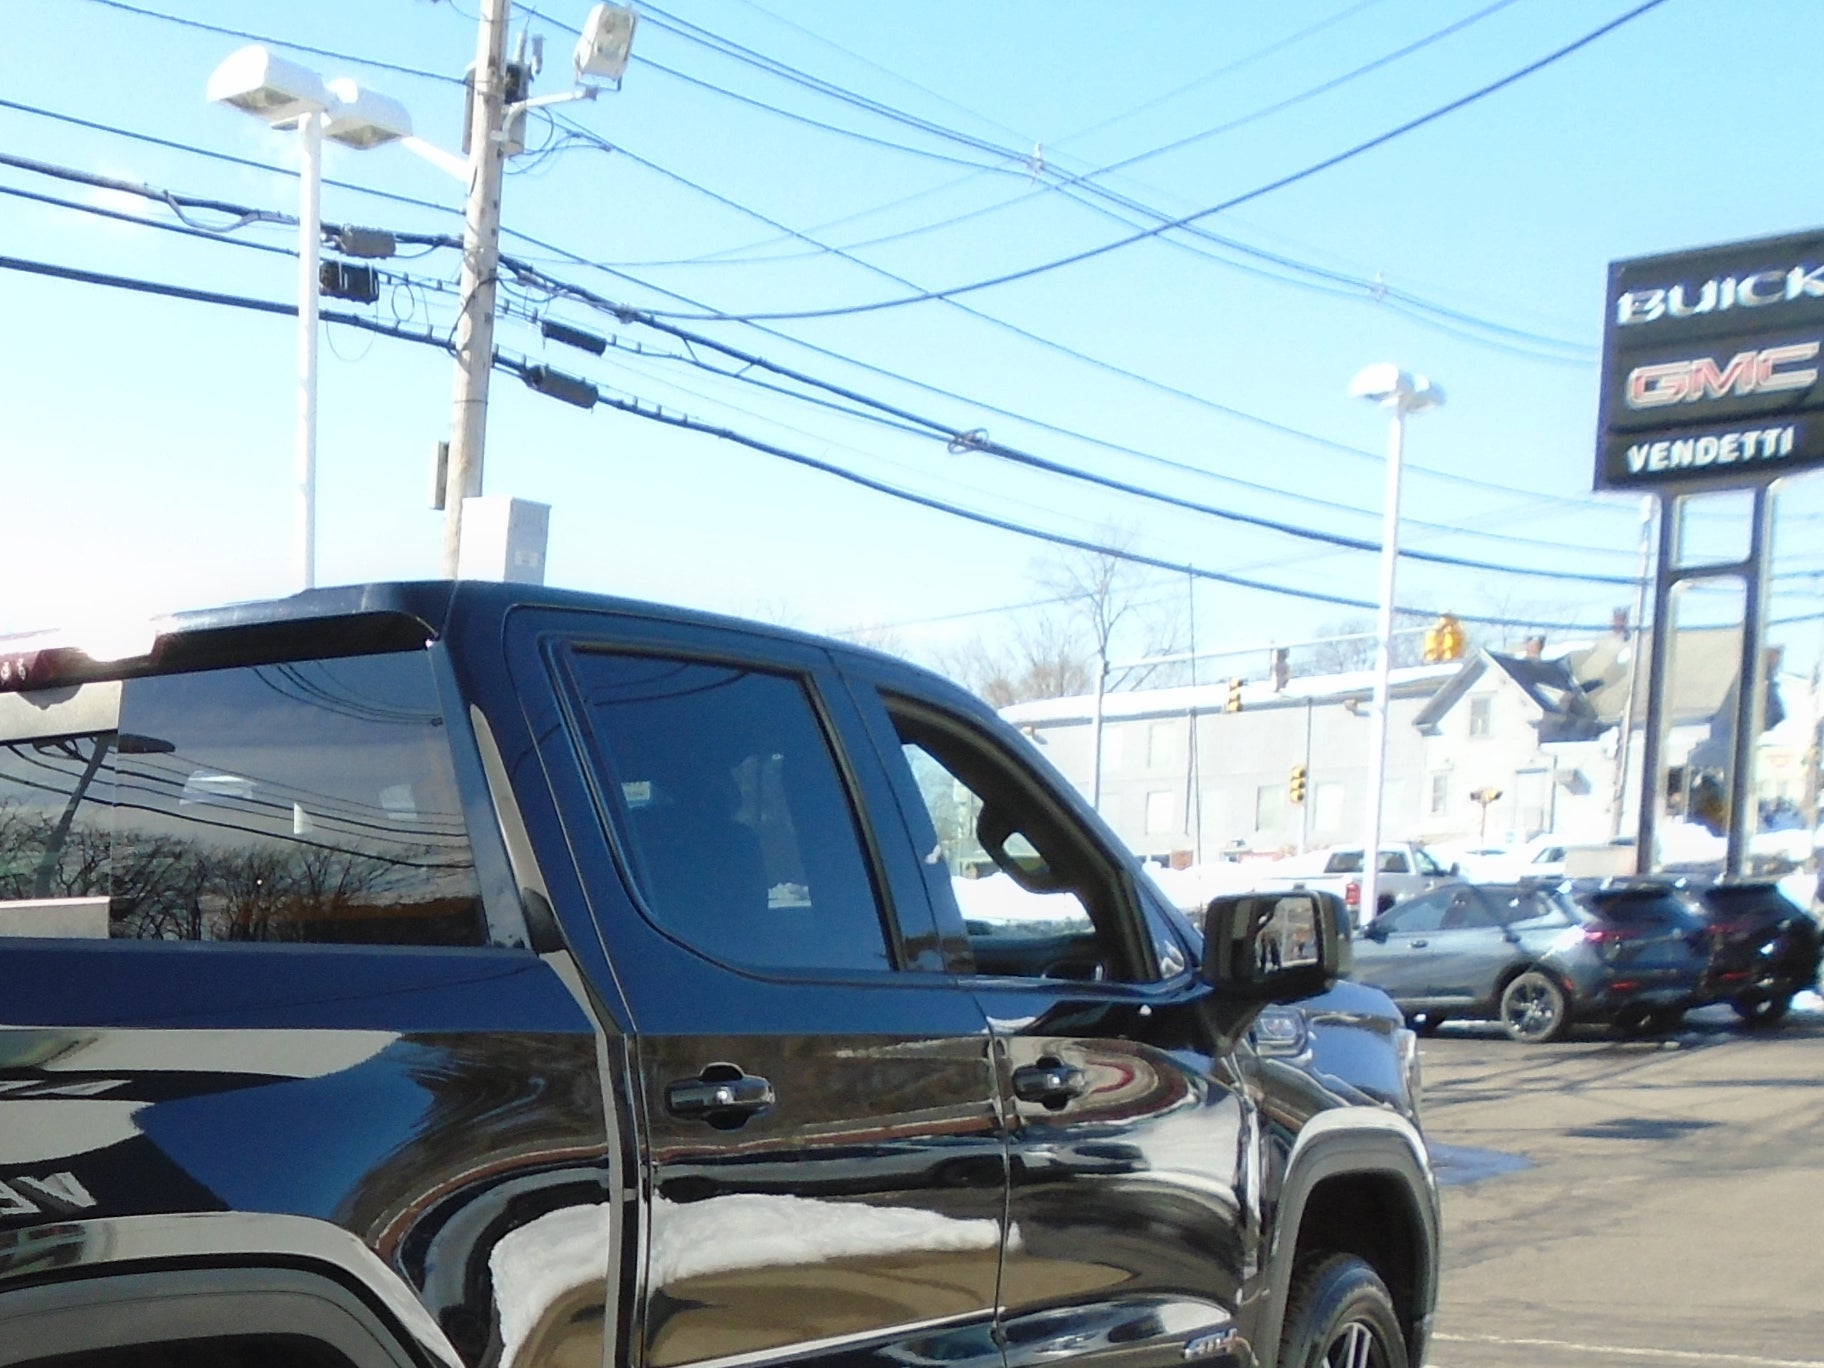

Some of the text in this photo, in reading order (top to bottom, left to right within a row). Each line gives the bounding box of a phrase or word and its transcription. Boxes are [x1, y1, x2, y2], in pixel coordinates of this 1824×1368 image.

[1616, 265, 1824, 326] BUICK
[1627, 341, 1821, 409] GMC
[1626, 426, 1795, 474] VENDETTI
